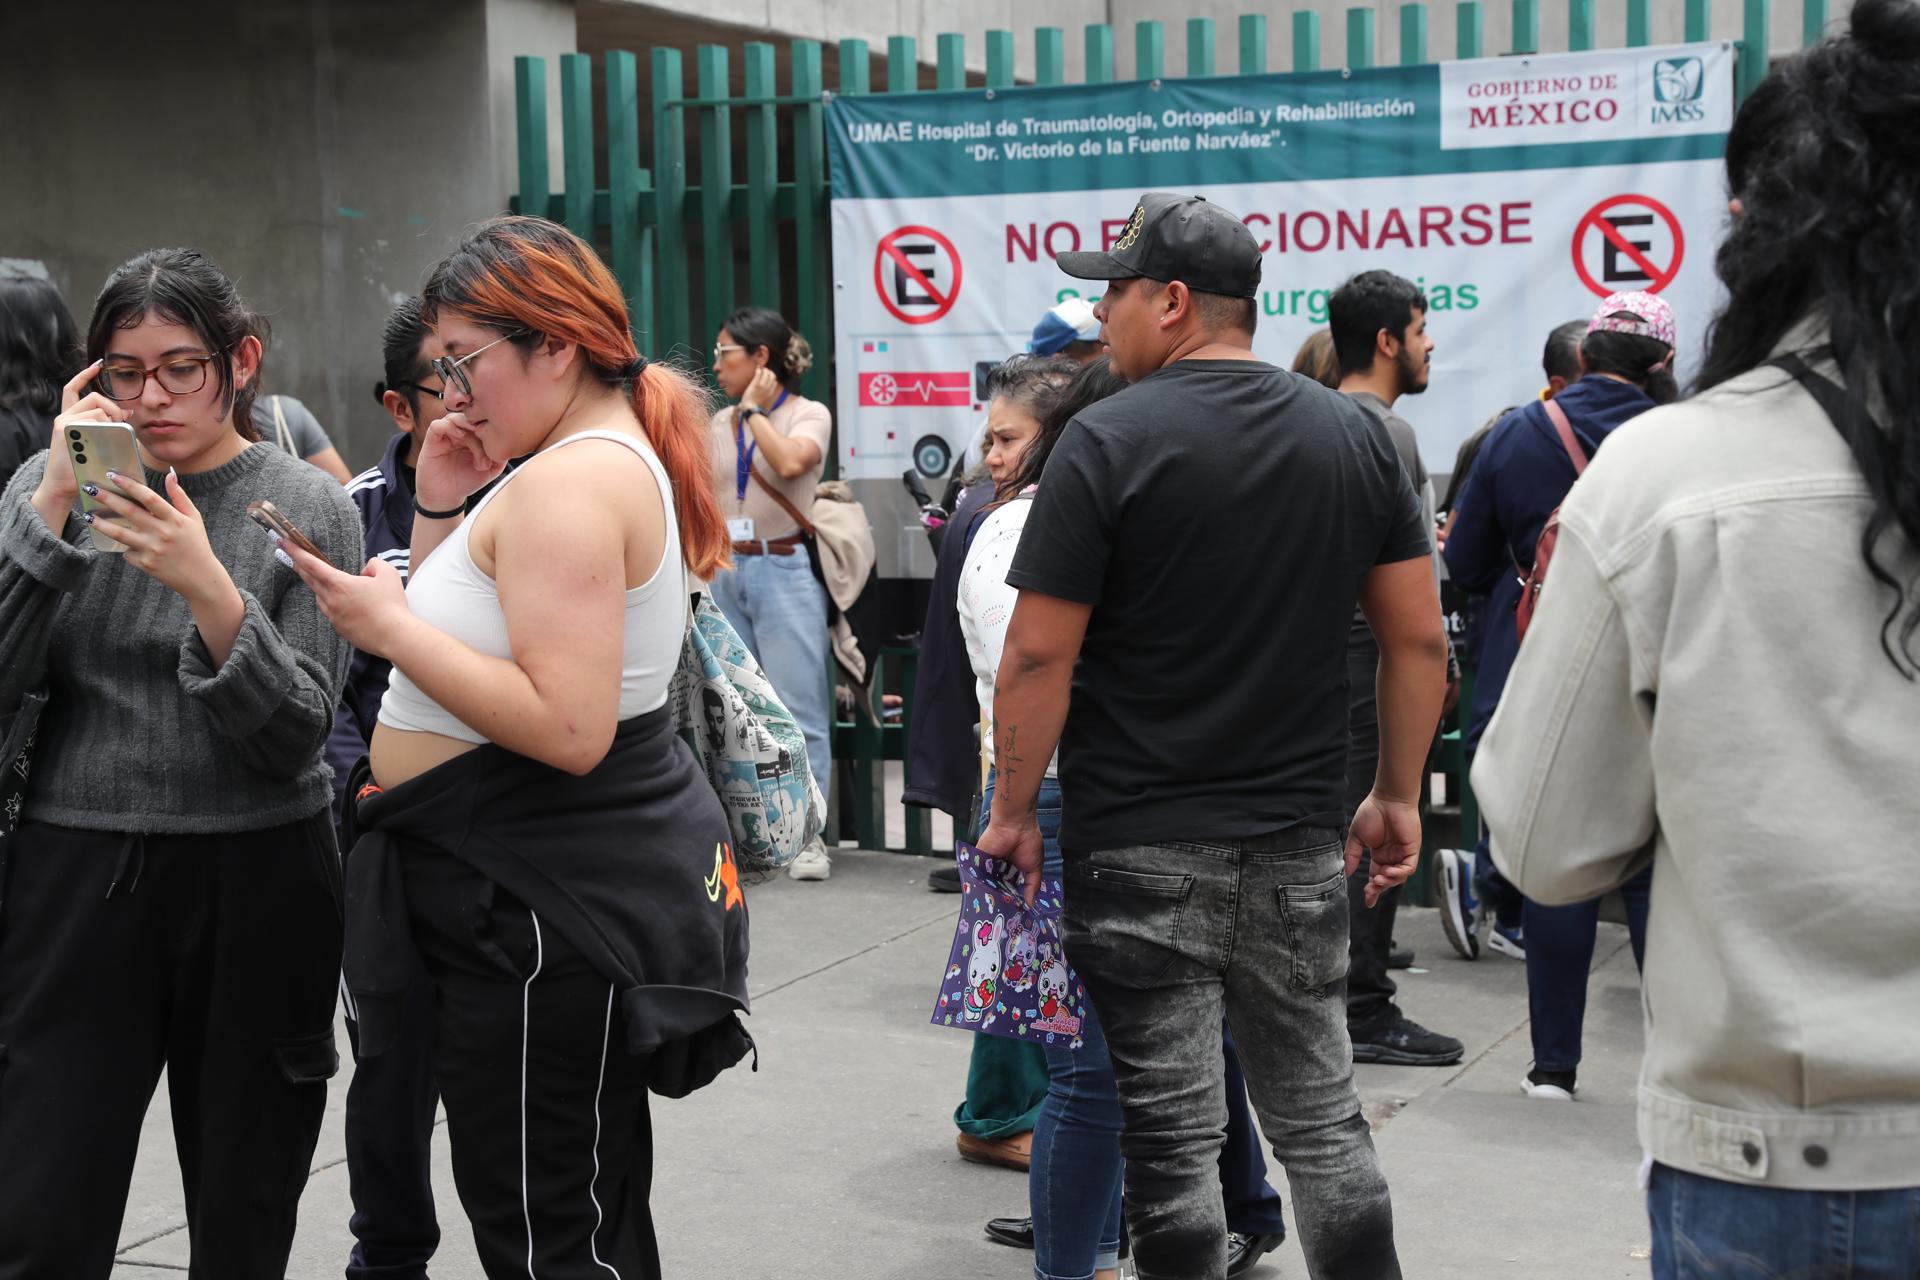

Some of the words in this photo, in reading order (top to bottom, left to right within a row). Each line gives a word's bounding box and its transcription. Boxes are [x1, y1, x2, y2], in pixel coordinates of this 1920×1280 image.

[1467, 76, 1581, 98] GOBIERNO
[1589, 74, 1618, 91] DE
[848, 121, 913, 143] UMAE
[918, 120, 991, 142] Hospital
[995, 118, 1018, 137] de
[1022, 111, 1158, 136] Traumatología,
[1162, 106, 1255, 130] Ortopedia
[1259, 108, 1271, 126] y
[1276, 99, 1415, 122] Rehabilitación
[1468, 97, 1618, 129] MÉXICO
[1651, 103, 1705, 124] IMSS
[1003, 141, 1075, 160] Victorio
[1079, 138, 1102, 156] de
[1107, 137, 1123, 155] la
[1128, 135, 1190, 153] Fuente
[1006, 221, 1081, 263] NO
[1102, 201, 1533, 254] ECIONARSE
